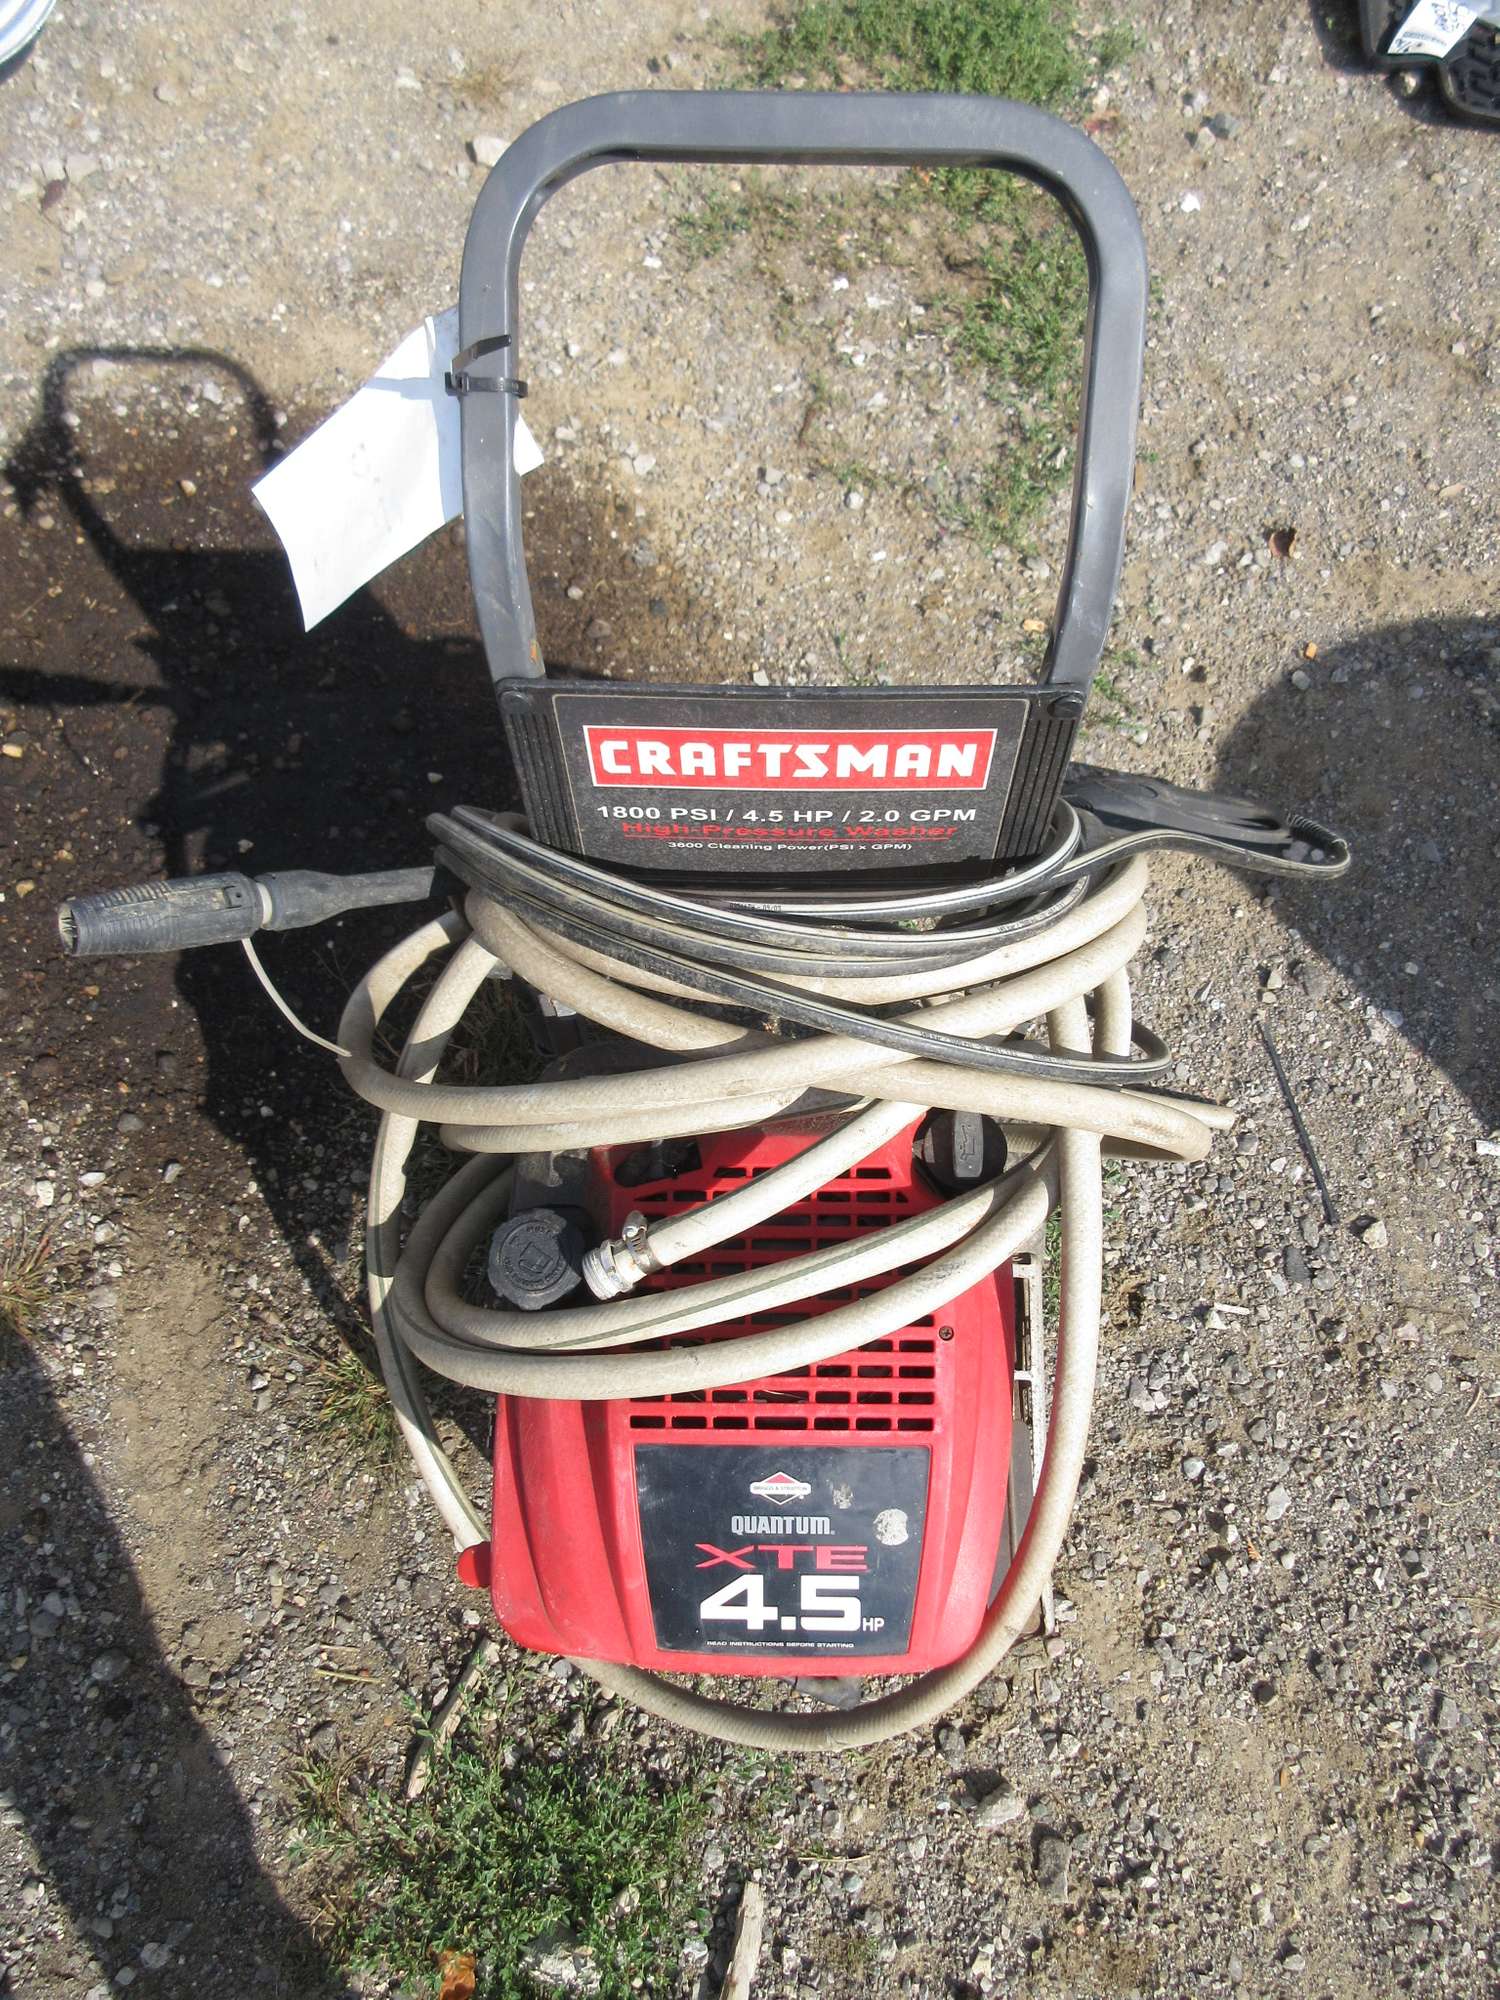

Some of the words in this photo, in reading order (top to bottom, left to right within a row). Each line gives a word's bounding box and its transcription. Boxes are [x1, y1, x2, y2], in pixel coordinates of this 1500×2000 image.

[599, 740, 978, 778] CRAFTSMAN
[597, 806, 660, 819] 1800
[670, 808, 717, 821] PSI
[726, 809, 734, 821] /
[742, 810, 784, 823] 4.5
[793, 810, 833, 823] HP
[841, 810, 851, 822] /
[858, 809, 900, 823] 2.0
[909, 809, 977, 822] GPM
[622, 822, 835, 837] High-Pressure
[845, 825, 958, 837] Washer
[707, 842, 773, 851] Cleaning
[871, 843, 912, 851] GPM)
[731, 1515, 831, 1535] QUANTUM
[695, 1543, 868, 1570] XTE
[700, 1574, 861, 1632] 4.5
[862, 1617, 885, 1632] HP
